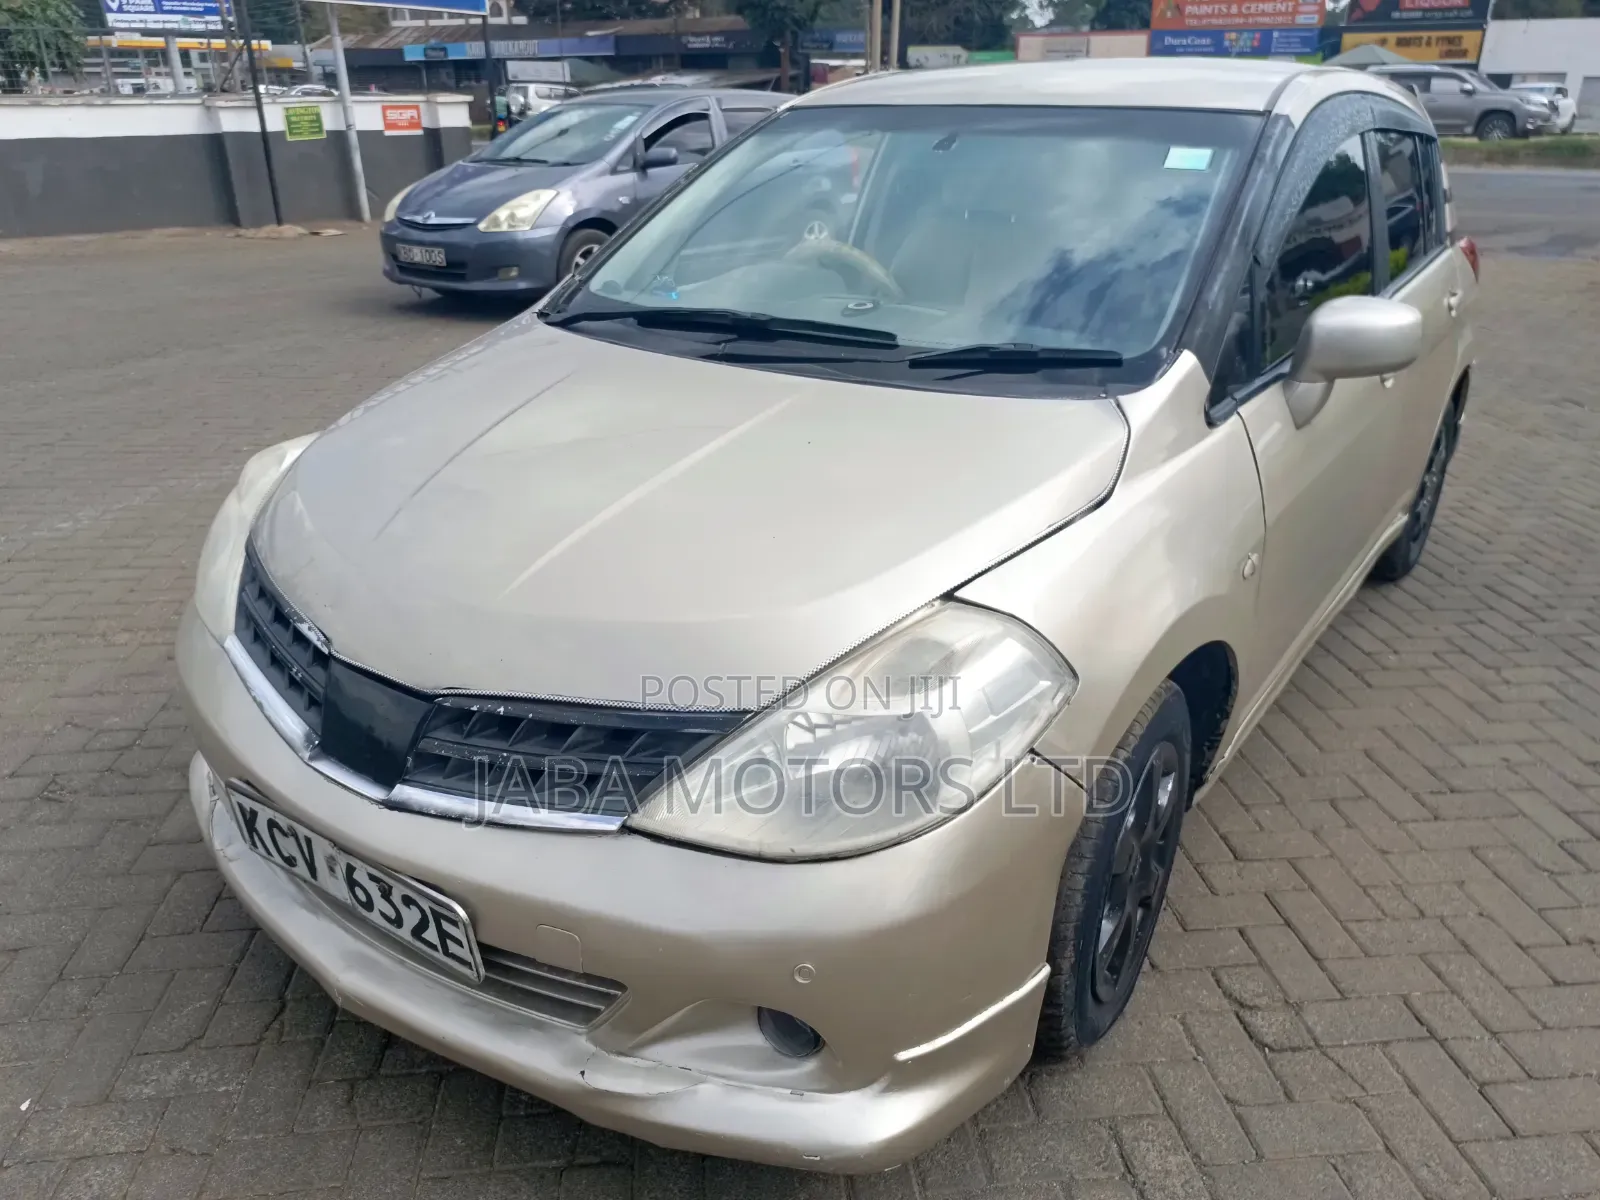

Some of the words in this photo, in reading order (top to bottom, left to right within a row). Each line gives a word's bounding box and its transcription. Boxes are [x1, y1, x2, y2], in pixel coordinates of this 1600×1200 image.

[1185, 4, 1228, 16] PAINTS
[1229, 3, 1238, 14] &
[1241, 1, 1295, 14] CEMENT
[386, 109, 419, 120] SGA
[236, 800, 318, 882] KCV
[345, 861, 474, 972] 632E
